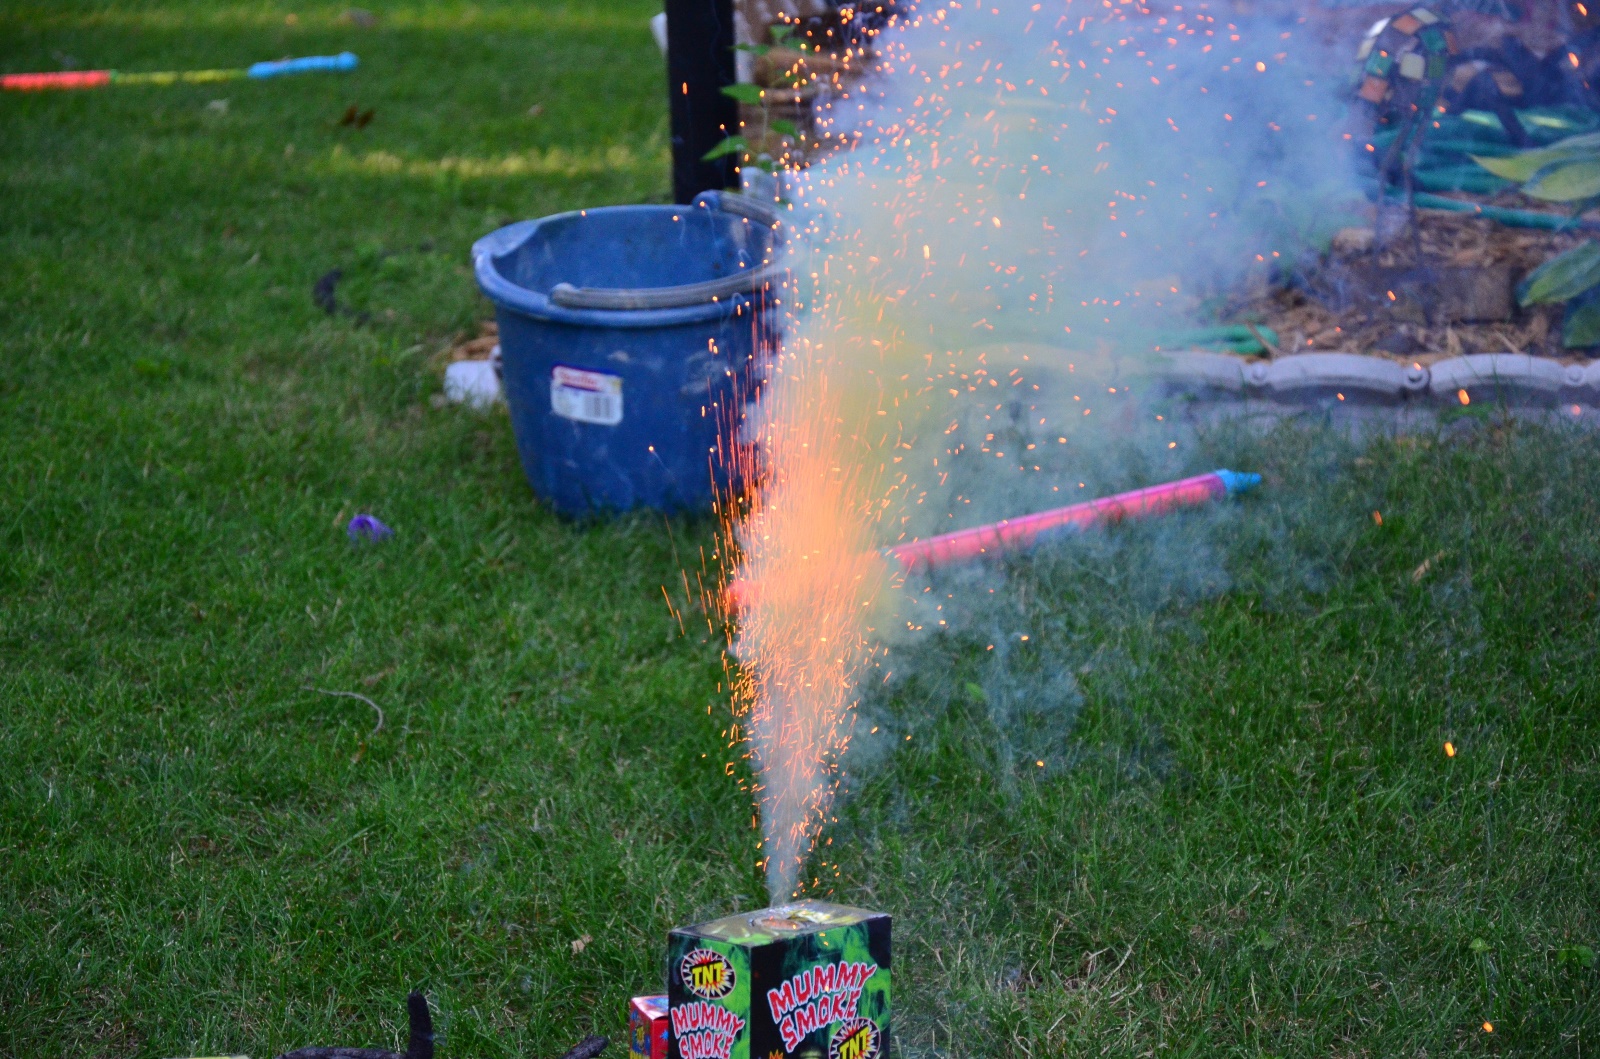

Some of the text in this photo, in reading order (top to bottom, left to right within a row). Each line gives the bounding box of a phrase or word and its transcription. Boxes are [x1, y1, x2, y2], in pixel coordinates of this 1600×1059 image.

[692, 962, 723, 988] TNT
[767, 961, 877, 1024] MUMMY
[671, 1001, 746, 1039] MUMMY
[780, 989, 861, 1053] SMOKE
[679, 1029, 735, 1059] SMOKE
[839, 1026, 870, 1059] TNT
